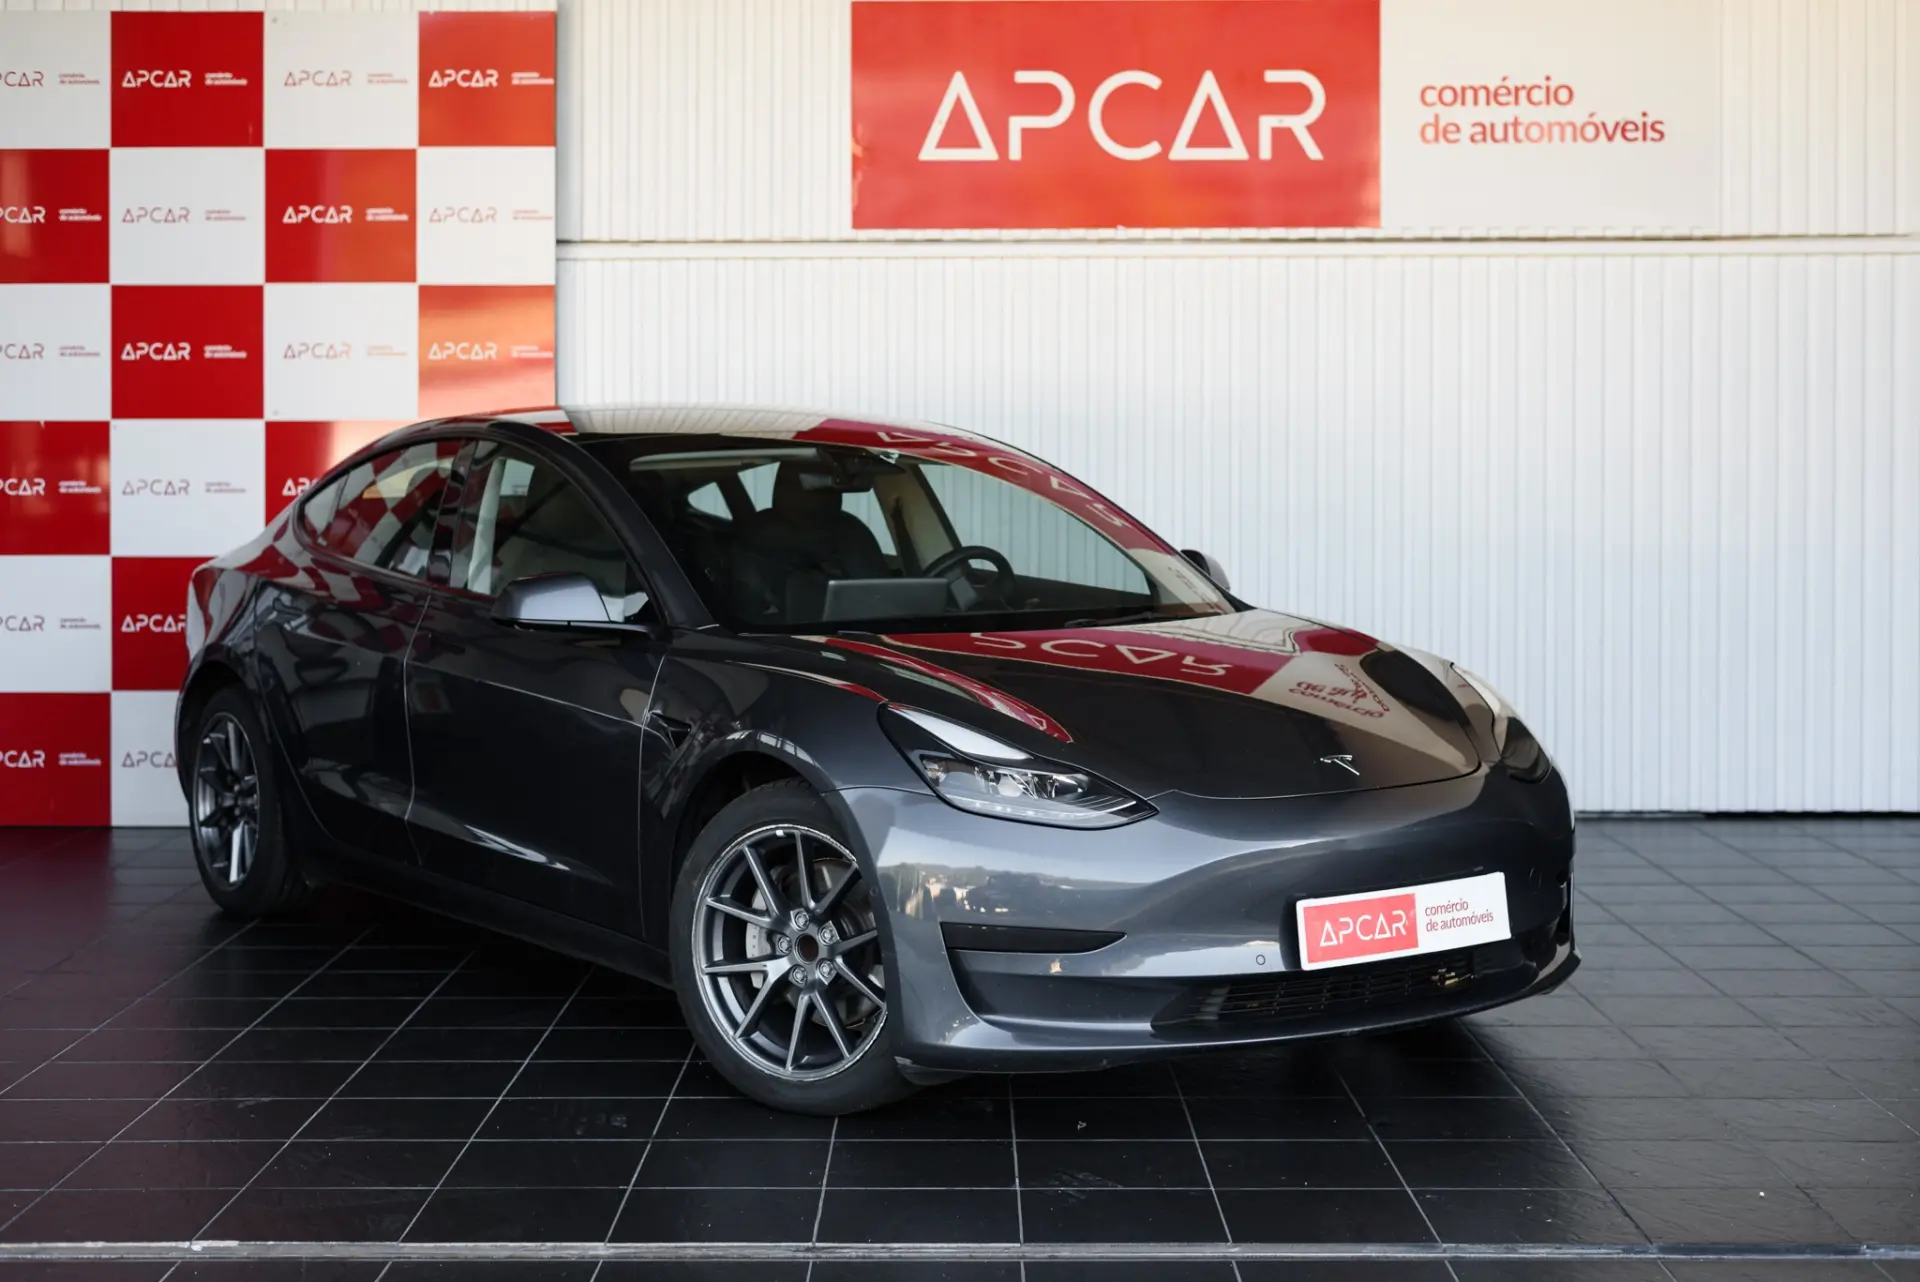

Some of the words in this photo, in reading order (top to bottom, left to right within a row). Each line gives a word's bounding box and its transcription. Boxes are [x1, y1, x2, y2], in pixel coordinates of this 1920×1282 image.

[0, 71, 44, 87] CAR
[121, 70, 192, 88] APCAR
[284, 70, 352, 87] APCAR
[428, 69, 498, 88] APCAR
[1420, 75, 1574, 107] comércio
[918, 70, 1326, 161] APCAR
[1420, 113, 1461, 144] de
[1469, 111, 1665, 144] automóveis
[0, 206, 46, 223] CAR
[122, 207, 190, 223] APCAR
[282, 205, 352, 223] APCAR
[429, 207, 497, 223] APCAR
[0, 343, 44, 359] CAR
[121, 342, 191, 360] APCAR
[283, 343, 351, 360] APCAR
[428, 341, 498, 360] APCAR
[0, 478, 45, 496] CAR
[122, 479, 190, 496] APCAR
[0, 615, 45, 631] CAR
[0, 750, 45, 768] CAR
[121, 751, 177, 768] APCA
[1425, 898, 1469, 916] comércio
[1320, 910, 1407, 947] APCAR
[1426, 918, 1438, 932] de
[1440, 909, 1494, 930] automóveis
